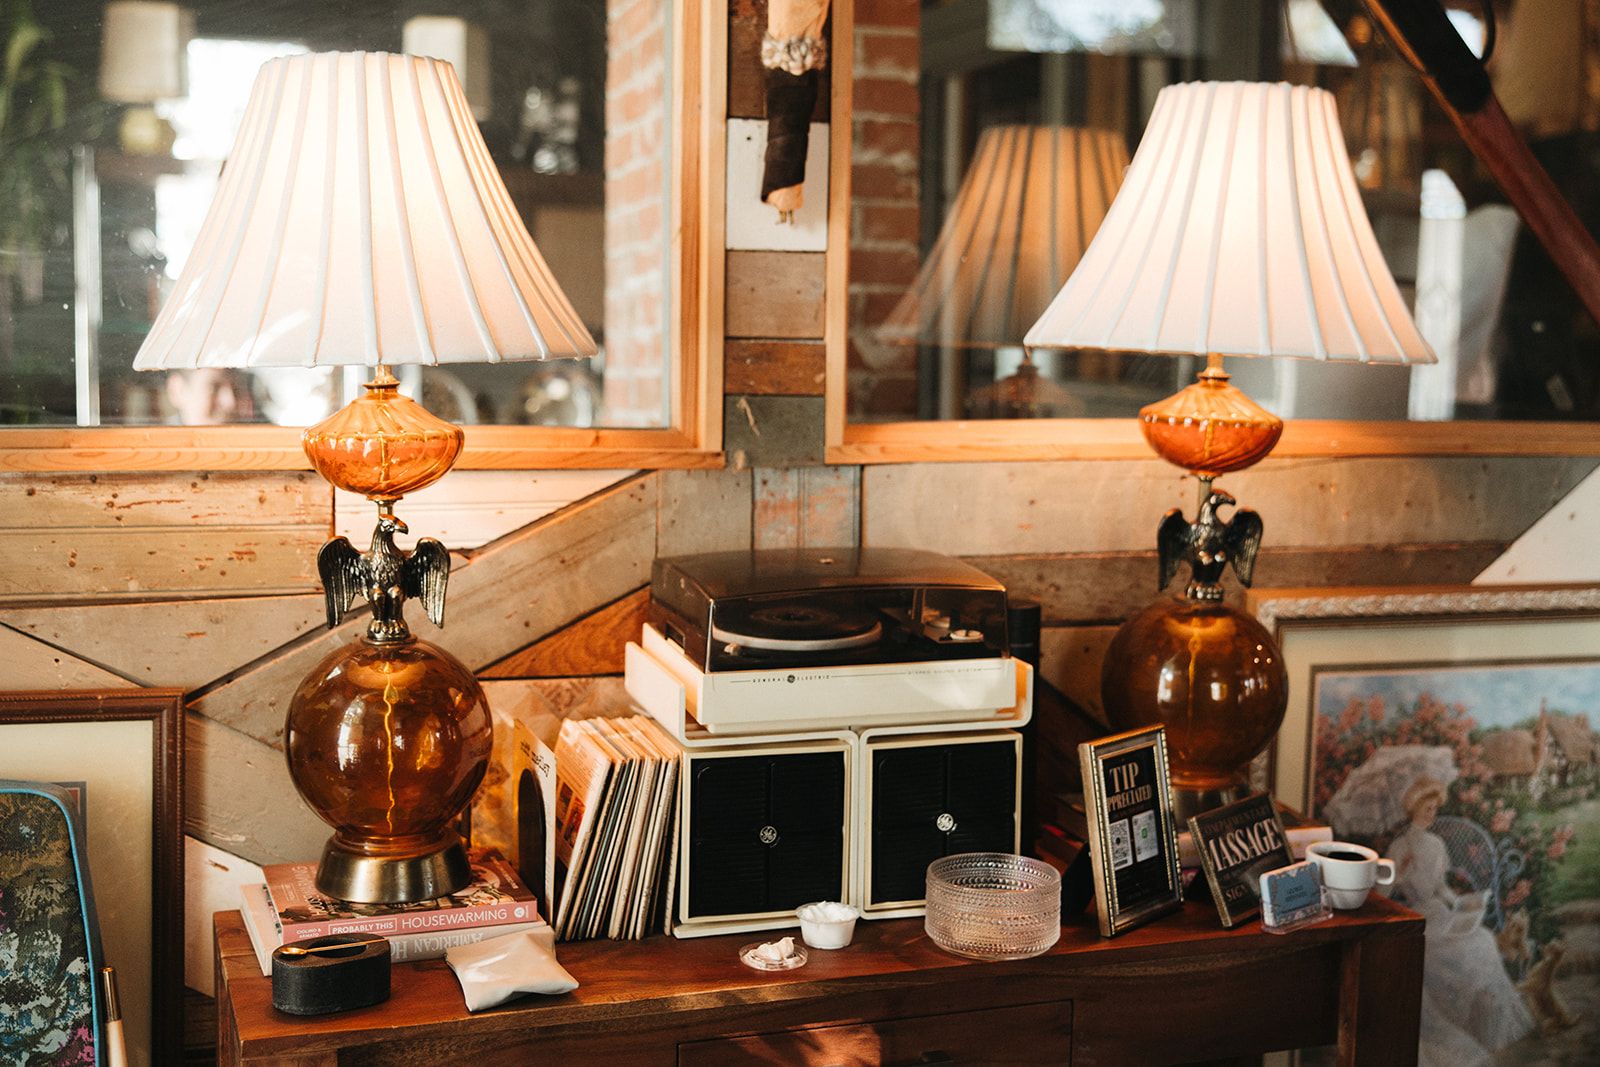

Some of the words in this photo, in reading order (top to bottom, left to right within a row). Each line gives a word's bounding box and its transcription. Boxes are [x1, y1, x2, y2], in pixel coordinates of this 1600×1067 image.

[1109, 761, 1139, 793] TIP
[1106, 783, 1152, 813] PPRECIATED
[332, 923, 374, 934] PROBABLY
[376, 921, 394, 930] THIS
[401, 907, 508, 930] HOUSEWARMING
[413, 931, 484, 953] AMERICAN
